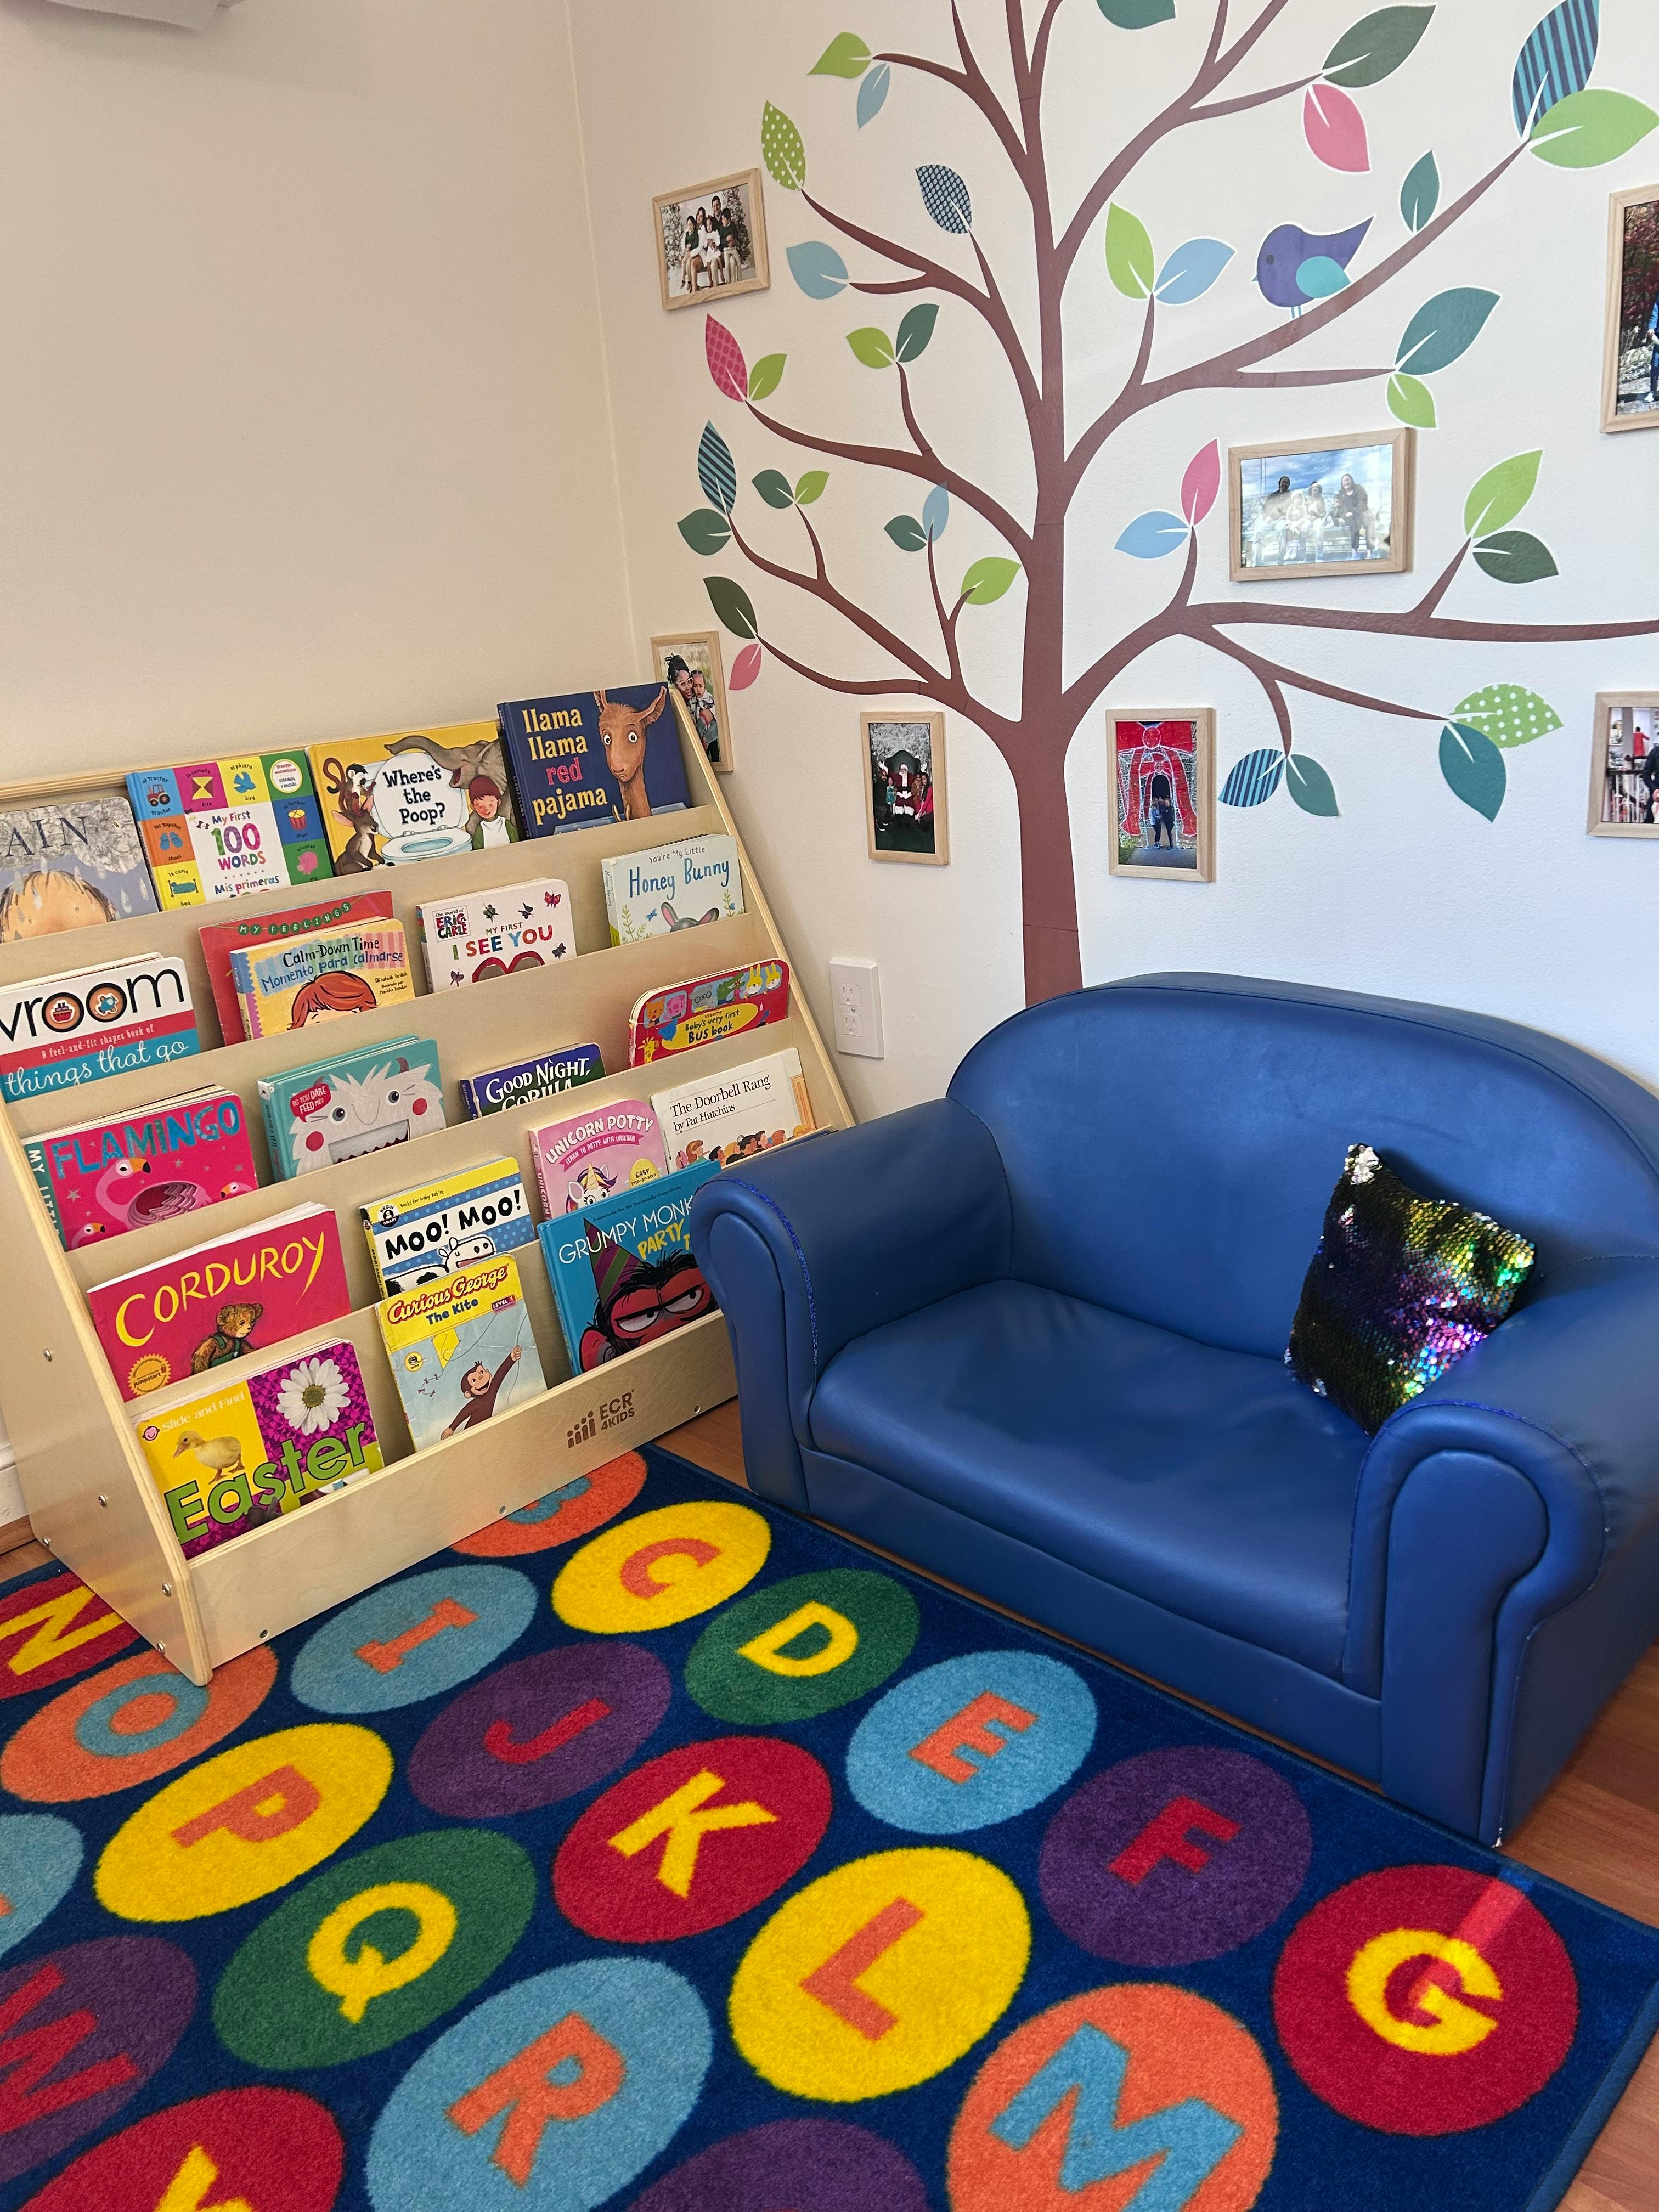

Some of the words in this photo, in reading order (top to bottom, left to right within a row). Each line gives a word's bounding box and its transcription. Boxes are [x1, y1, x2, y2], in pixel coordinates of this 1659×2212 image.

[521, 708, 583, 733] llama
[527, 735, 589, 761] llama
[382, 765, 441, 788] Where's
[545, 757, 583, 785] red
[151, 807, 172, 816] tractor
[403, 788, 431, 804] the
[532, 787, 608, 826] pajama
[212, 815, 227, 826] My
[230, 810, 251, 822] First
[399, 802, 445, 826] Poop?
[0, 816, 89, 857] AIN
[211, 823, 261, 856] 100
[218, 851, 267, 871] WORDS
[649, 852, 670, 864] You're
[673, 849, 683, 859] My
[685, 845, 706, 856] Little
[215, 883, 233, 894] Mis
[235, 875, 280, 894] primeras
[629, 866, 675, 900] Honey
[684, 858, 730, 887] Bunny
[239, 924, 261, 935] MY
[270, 902, 351, 934] FEELINGS
[436, 913, 467, 929] ERIC
[437, 923, 467, 939] CARLE
[486, 927, 498, 935] MY
[500, 922, 523, 932] FIRST
[283, 942, 351, 967] Calm-Down
[352, 937, 380, 952] Time
[452, 944, 459, 960] I
[466, 935, 503, 957] SEE
[507, 924, 553, 947] YOU
[261, 965, 314, 992] Momento
[319, 958, 348, 973] para
[353, 951, 403, 964] calmarse
[0, 969, 184, 1042] vroom
[685, 1017, 706, 1032] Baby's
[707, 1014, 724, 1029] very
[725, 1009, 740, 1020] first
[49, 1039, 98, 1058] feel-and-fit
[100, 1032, 125, 1047] shapes
[127, 1028, 143, 1039] book
[146, 1024, 154, 1034] of
[689, 1029, 708, 1043] BUS
[711, 1021, 733, 1038] book
[5, 1062, 93, 1096] things
[97, 1040, 151, 1073] that
[156, 1040, 189, 1062] go
[299, 1094, 312, 1105] YOU
[310, 1085, 327, 1101] DARE
[486, 1071, 533, 1103] GOOD
[670, 1101, 692, 1118] The
[694, 1084, 741, 1110] Doorbell
[742, 1075, 771, 1093] Rang
[300, 1102, 315, 1115] FEED
[673, 1121, 684, 1133] by
[686, 1116, 698, 1128] Pat
[699, 1103, 736, 1122] Hutchins
[52, 1101, 240, 1180] FLAMINGO
[545, 1118, 604, 1164] UNICORN
[607, 1114, 653, 1132] POTTY
[565, 1151, 580, 1165] LEARN
[587, 1140, 602, 1151] POTTY
[28, 1149, 45, 1173] MY
[635, 1168, 650, 1178] EASY
[380, 1205, 394, 1214] BEGIN
[537, 1172, 550, 1217] UNICORN
[385, 1214, 449, 1260] MOO!
[459, 1189, 521, 1230] MOO!
[559, 1217, 636, 1264] GRUMPY
[637, 1218, 685, 1260] PARTY
[116, 1231, 324, 1347] CORDUROY
[388, 1290, 450, 1324] Curious
[451, 1267, 509, 1296] George
[493, 1299, 508, 1308] LEVEL
[426, 1311, 449, 1325] The
[454, 1298, 479, 1315] Kite
[133, 1372, 162, 1389] jumpstart
[162, 1413, 191, 1433] Slide
[194, 1402, 217, 1420] and
[219, 1391, 245, 1410] Find
[600, 1392, 633, 1421] ECR
[601, 1407, 635, 1431] 4KIDS
[164, 1422, 365, 1545] Easter
[620, 1538, 722, 1599] C
[354, 1598, 480, 1674] I
[735, 1600, 859, 1677] D
[75, 1673, 209, 1758] O
[483, 1698, 614, 1764] J
[907, 1690, 1039, 1785] E
[171, 1765, 322, 1848] P
[608, 1767, 779, 1899] K
[1108, 1795, 1244, 1887] F
[307, 1881, 458, 2024] Q
[799, 1896, 925, 2041] L
[1346, 1928, 1503, 2056] G
[445, 2012, 627, 2190] R
[989, 2021, 1244, 2212] M
